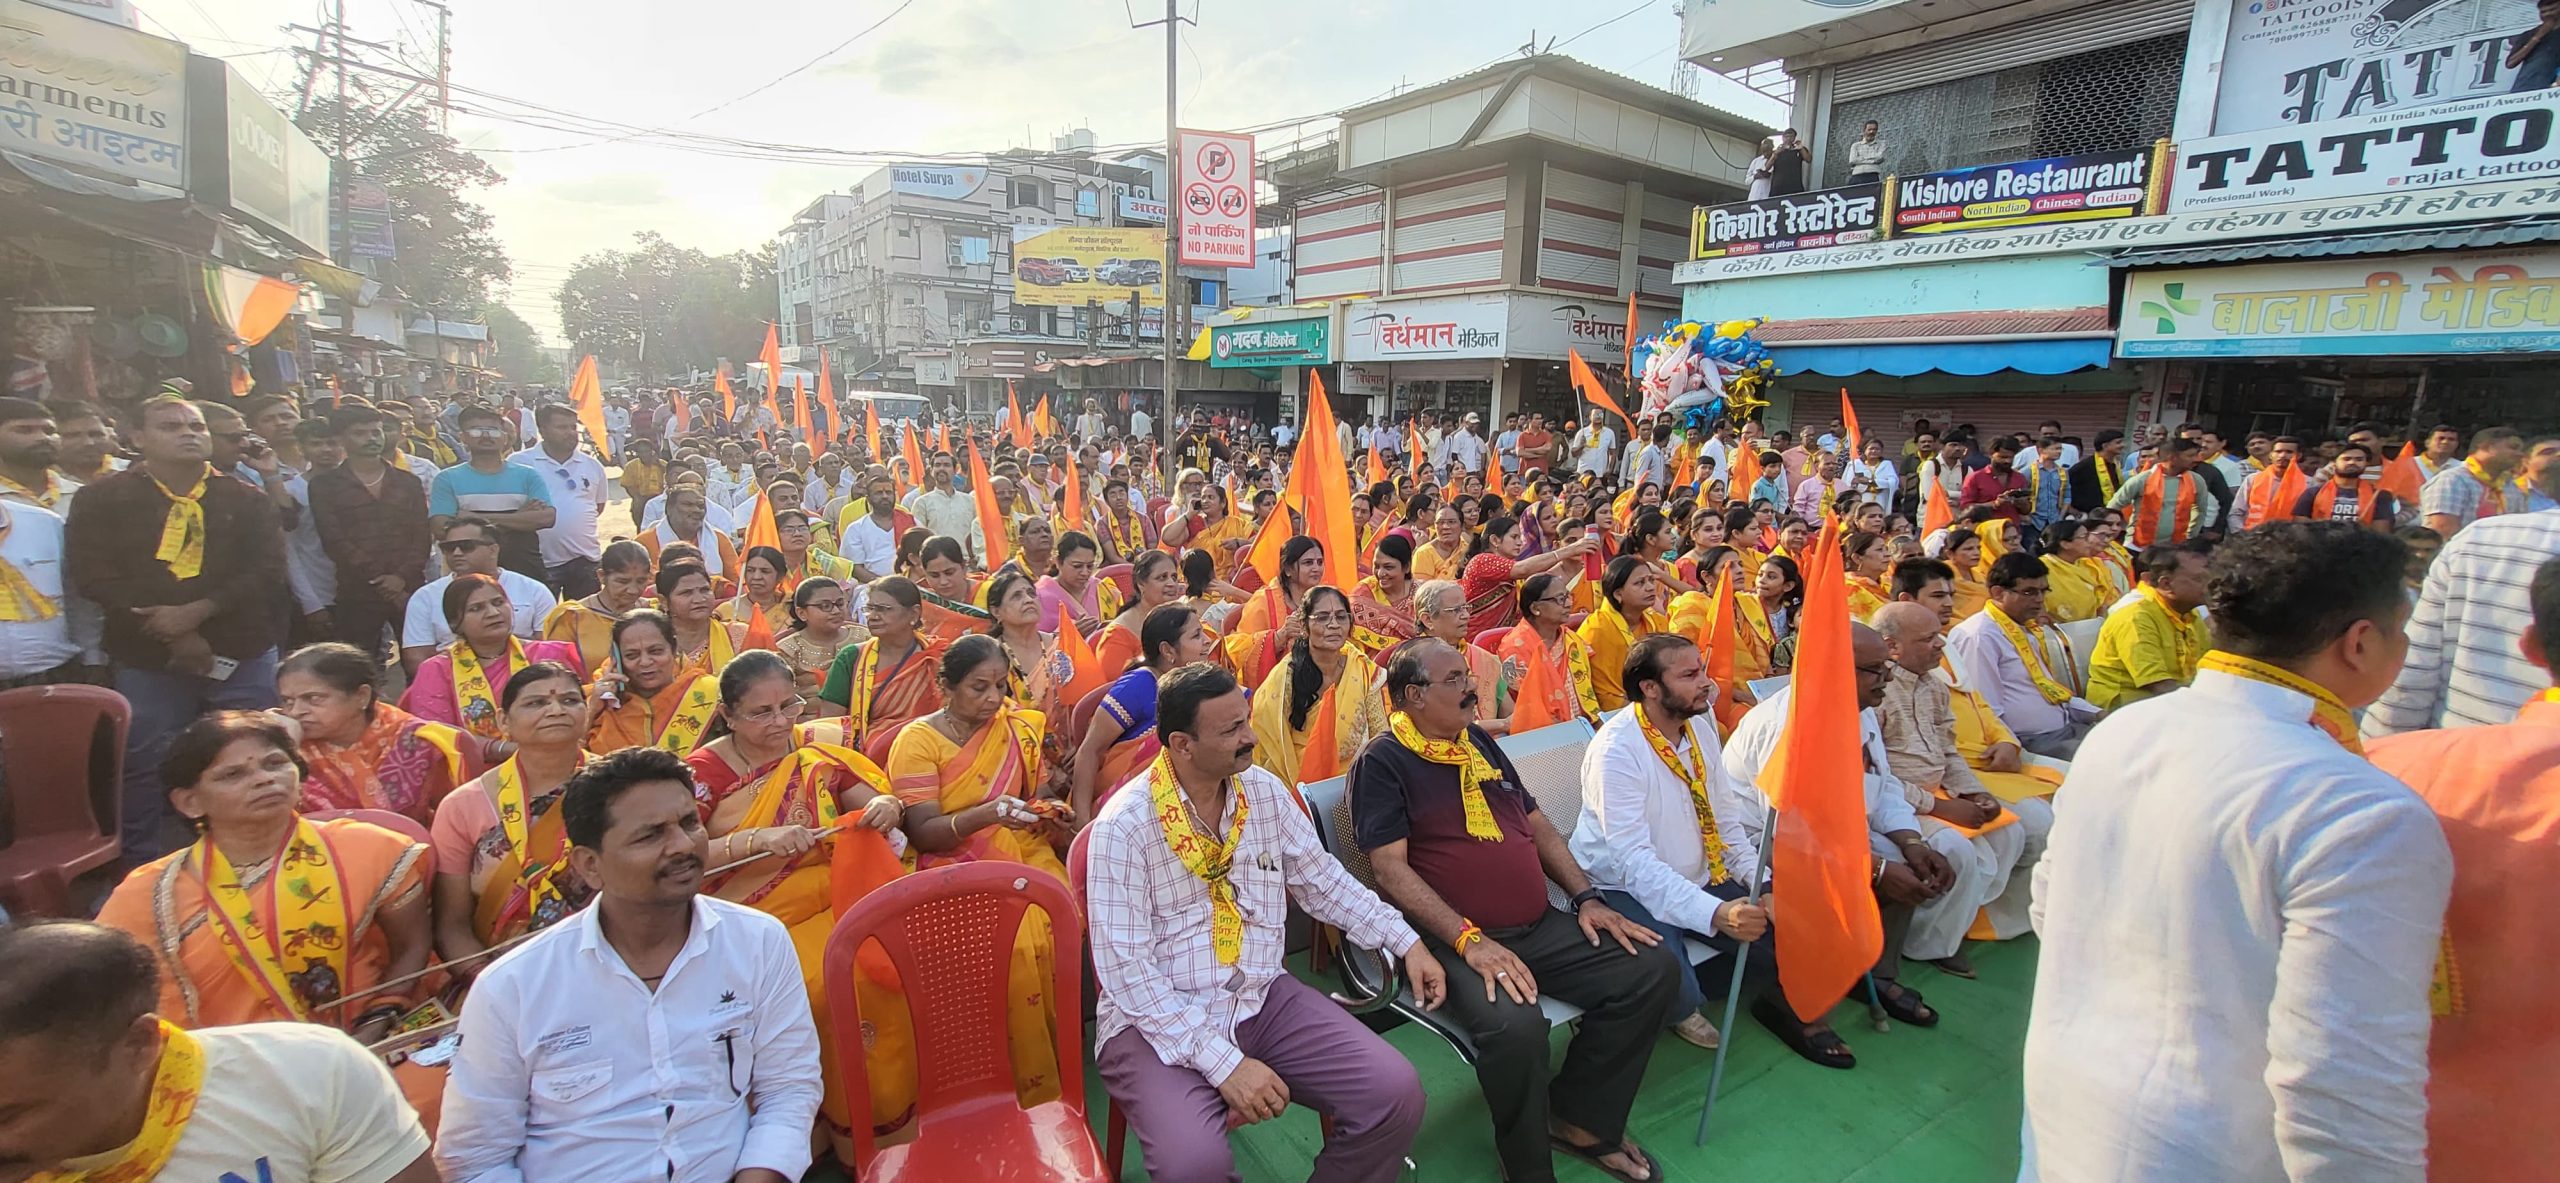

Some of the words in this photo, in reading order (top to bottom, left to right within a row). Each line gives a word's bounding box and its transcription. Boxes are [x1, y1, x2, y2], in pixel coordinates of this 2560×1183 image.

[2241, 28, 2282, 41] Contact
[2369, 115, 2387, 124] All
[2390, 111, 2425, 121] India
[2493, 93, 2542, 106] Award
[52, 119, 181, 169] आइटम
[235, 113, 285, 173] JOCKEY
[892, 168, 922, 183] Hotel
[923, 172, 954, 186] Surya
[1900, 176, 1988, 208] Kishore
[1994, 153, 2146, 198] Restaurant
[1901, 210, 1926, 222] South
[1928, 208, 1957, 219] Indian
[1967, 205, 1993, 216] North
[1995, 201, 2026, 213] Indian
[2036, 196, 2081, 209] Chinese
[2090, 192, 2136, 204] Indian
[2183, 191, 2256, 207] (Professional
[2259, 186, 2295, 197] Work)
[1187, 222, 1201, 236] नो
[1205, 223, 1245, 239] पार्किंग
[1708, 204, 1779, 243] किशोर
[1780, 193, 1876, 235] रेस्टोरेन्ट
[1893, 237, 2000, 257] वैवाहिक
[2118, 216, 2178, 240] एवं
[2186, 211, 2294, 232] लहंगा
[2299, 195, 2415, 228] चुनरी
[2417, 190, 2513, 216] होल
[1188, 241, 1201, 254] NO
[1204, 242, 1245, 256] PARKING
[2212, 271, 2411, 335] बालाजी
[1232, 330, 1264, 349] मदन
[1382, 316, 1457, 349] वर्धमान
[1458, 327, 1499, 348] मेडिकल
